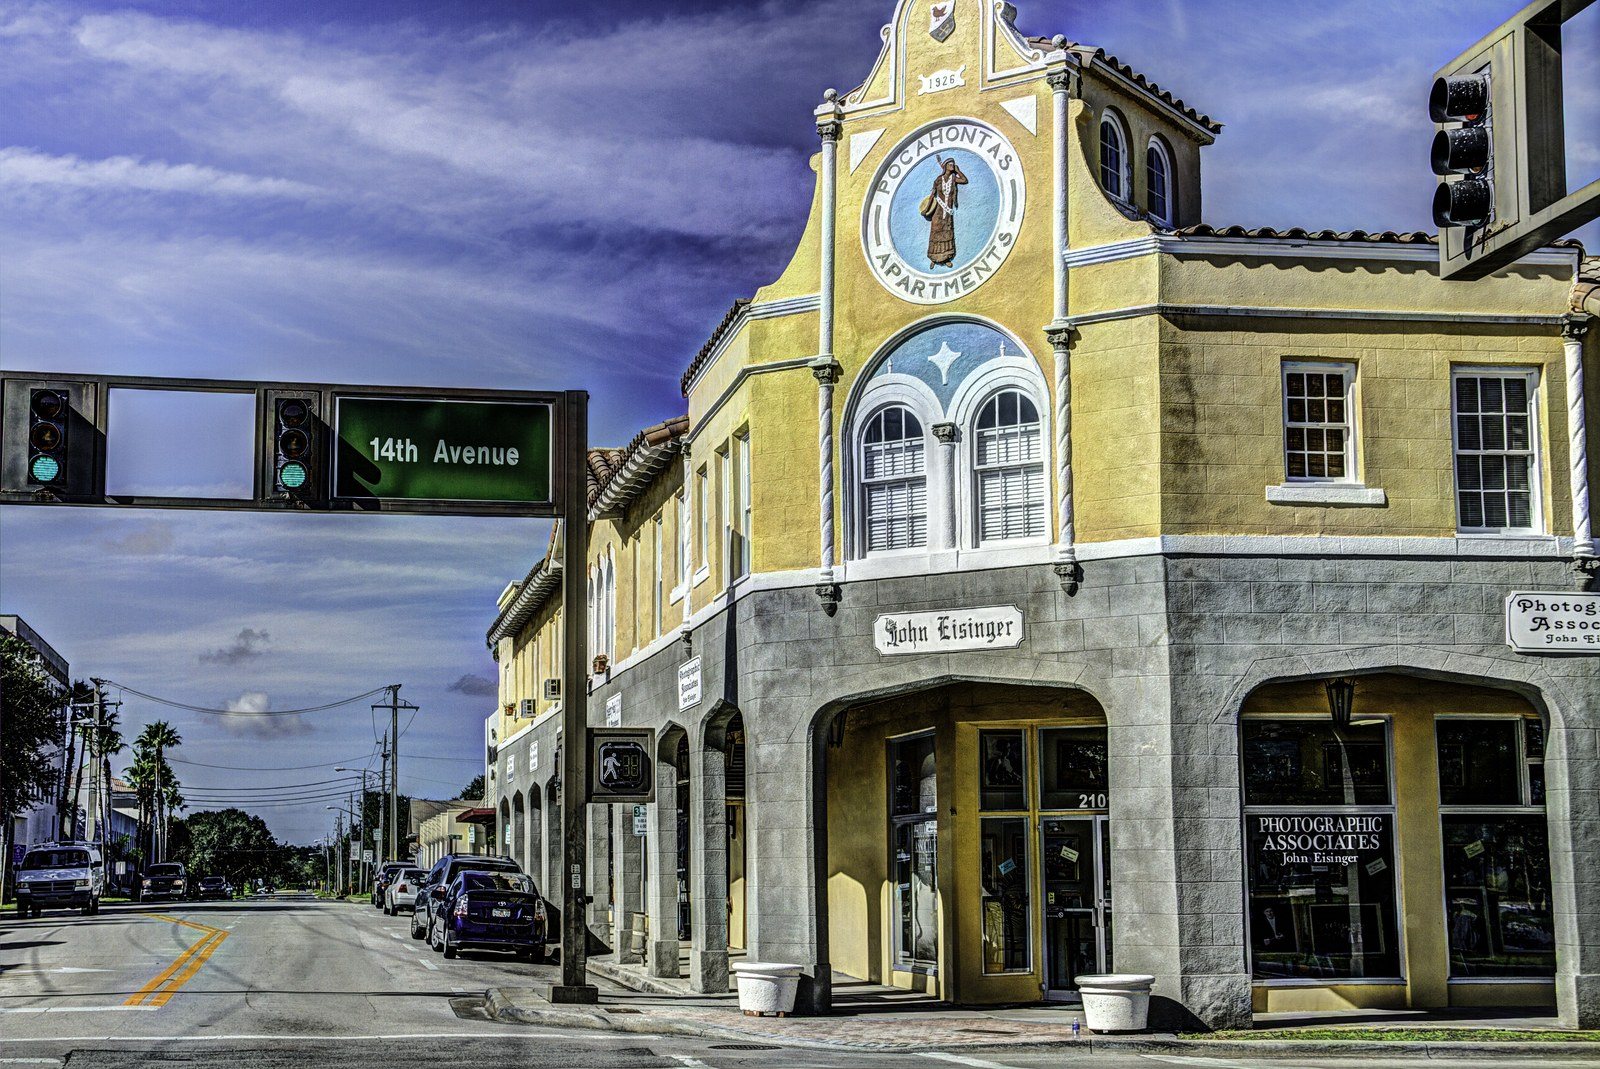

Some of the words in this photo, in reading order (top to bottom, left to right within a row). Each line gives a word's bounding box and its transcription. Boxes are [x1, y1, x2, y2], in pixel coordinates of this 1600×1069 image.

[929, 74, 955, 90] 1926
[876, 125, 1013, 195] POCAHONTAS
[876, 231, 1013, 300] APARTMENTS
[369, 437, 418, 463] 14th
[433, 439, 519, 466] Avenue
[1517, 599, 1600, 616] Photog
[884, 617, 928, 649] John
[936, 615, 1014, 644] Eisinger
[1529, 616, 1600, 632] Assoc
[1545, 634, 1578, 644] John
[1079, 793, 1110, 809] 210
[1259, 816, 1383, 833] PHOTOGRAPHIC
[1262, 834, 1380, 851] ASSOCIATES
[1280, 852, 1309, 867] John
[1313, 852, 1359, 867] Eisinger
